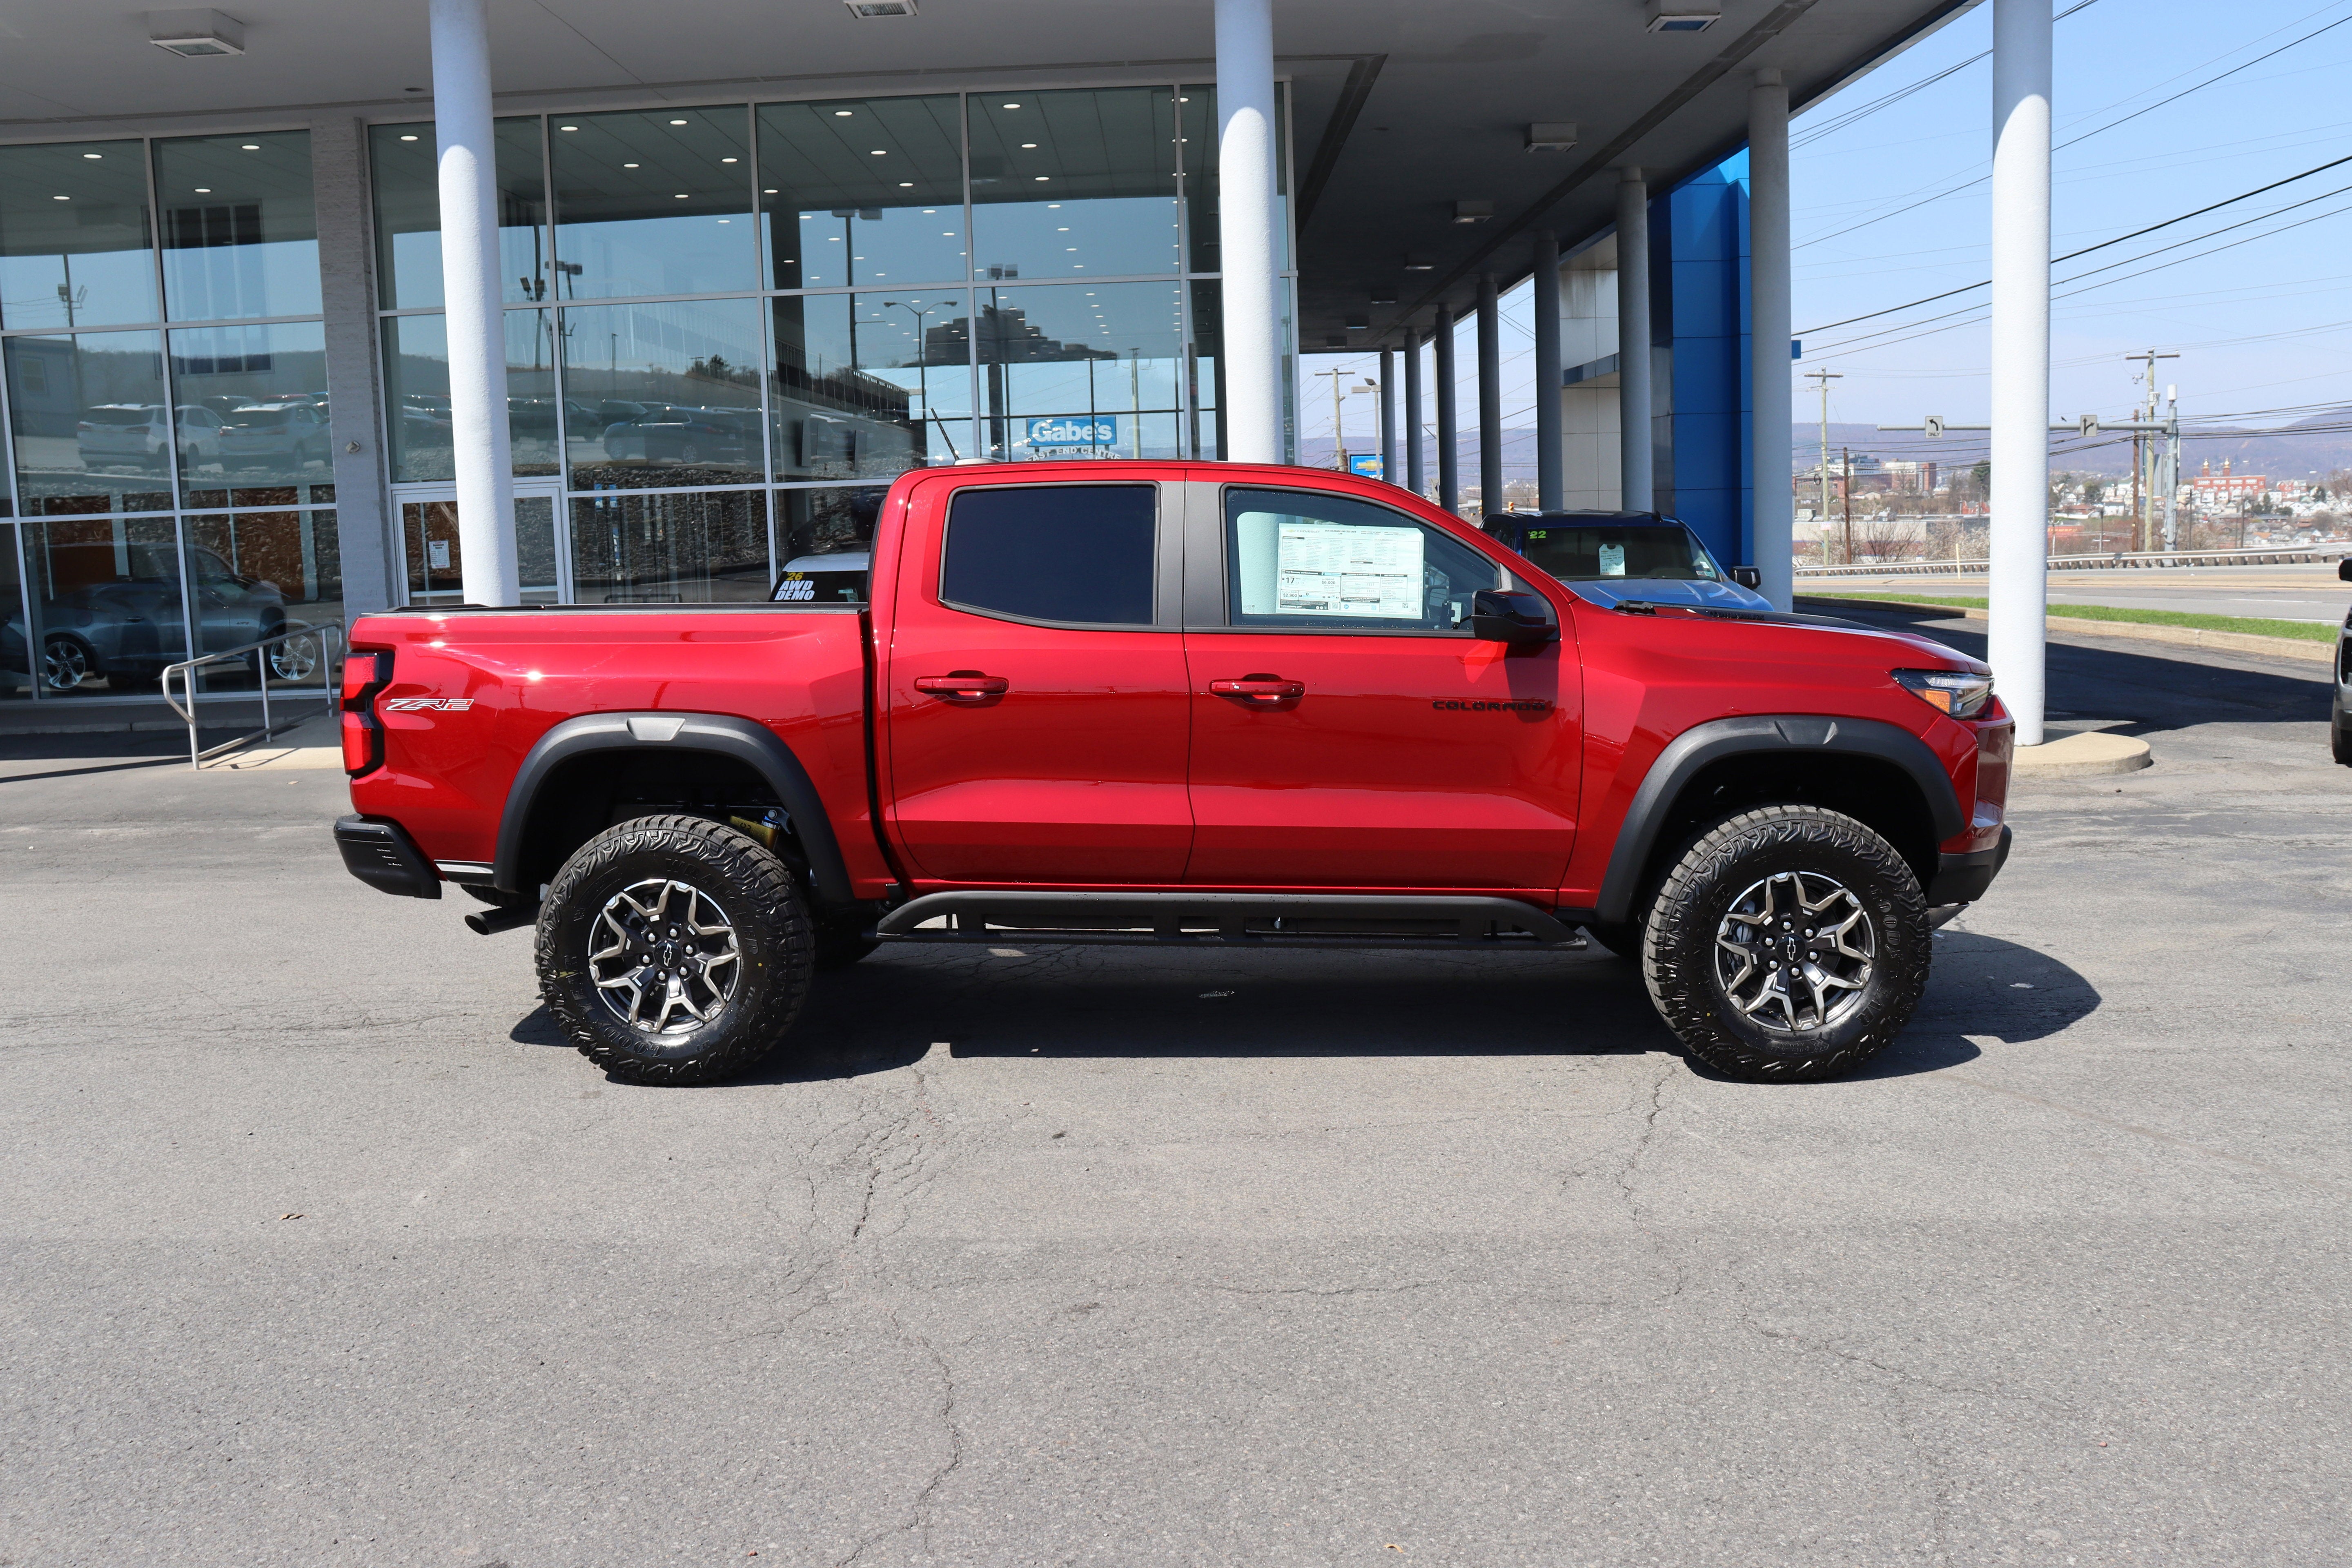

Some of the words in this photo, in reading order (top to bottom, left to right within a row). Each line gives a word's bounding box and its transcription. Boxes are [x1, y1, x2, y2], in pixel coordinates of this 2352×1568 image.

[1032, 421, 1112, 442] Gabe's
[1024, 450, 1051, 461] EAST
[1056, 447, 1079, 455] END
[1081, 447, 1121, 459] CENTRE
[1528, 530, 1546, 539] '22
[786, 572, 804, 581] '26
[779, 580, 814, 590] AWD
[774, 590, 815, 601] DEMO
[385, 698, 474, 711] ZR2
[1432, 701, 1546, 711] COLORADO
[665, 858, 759, 955] WRANGLER
[566, 954, 665, 1058] GOODYEAR
